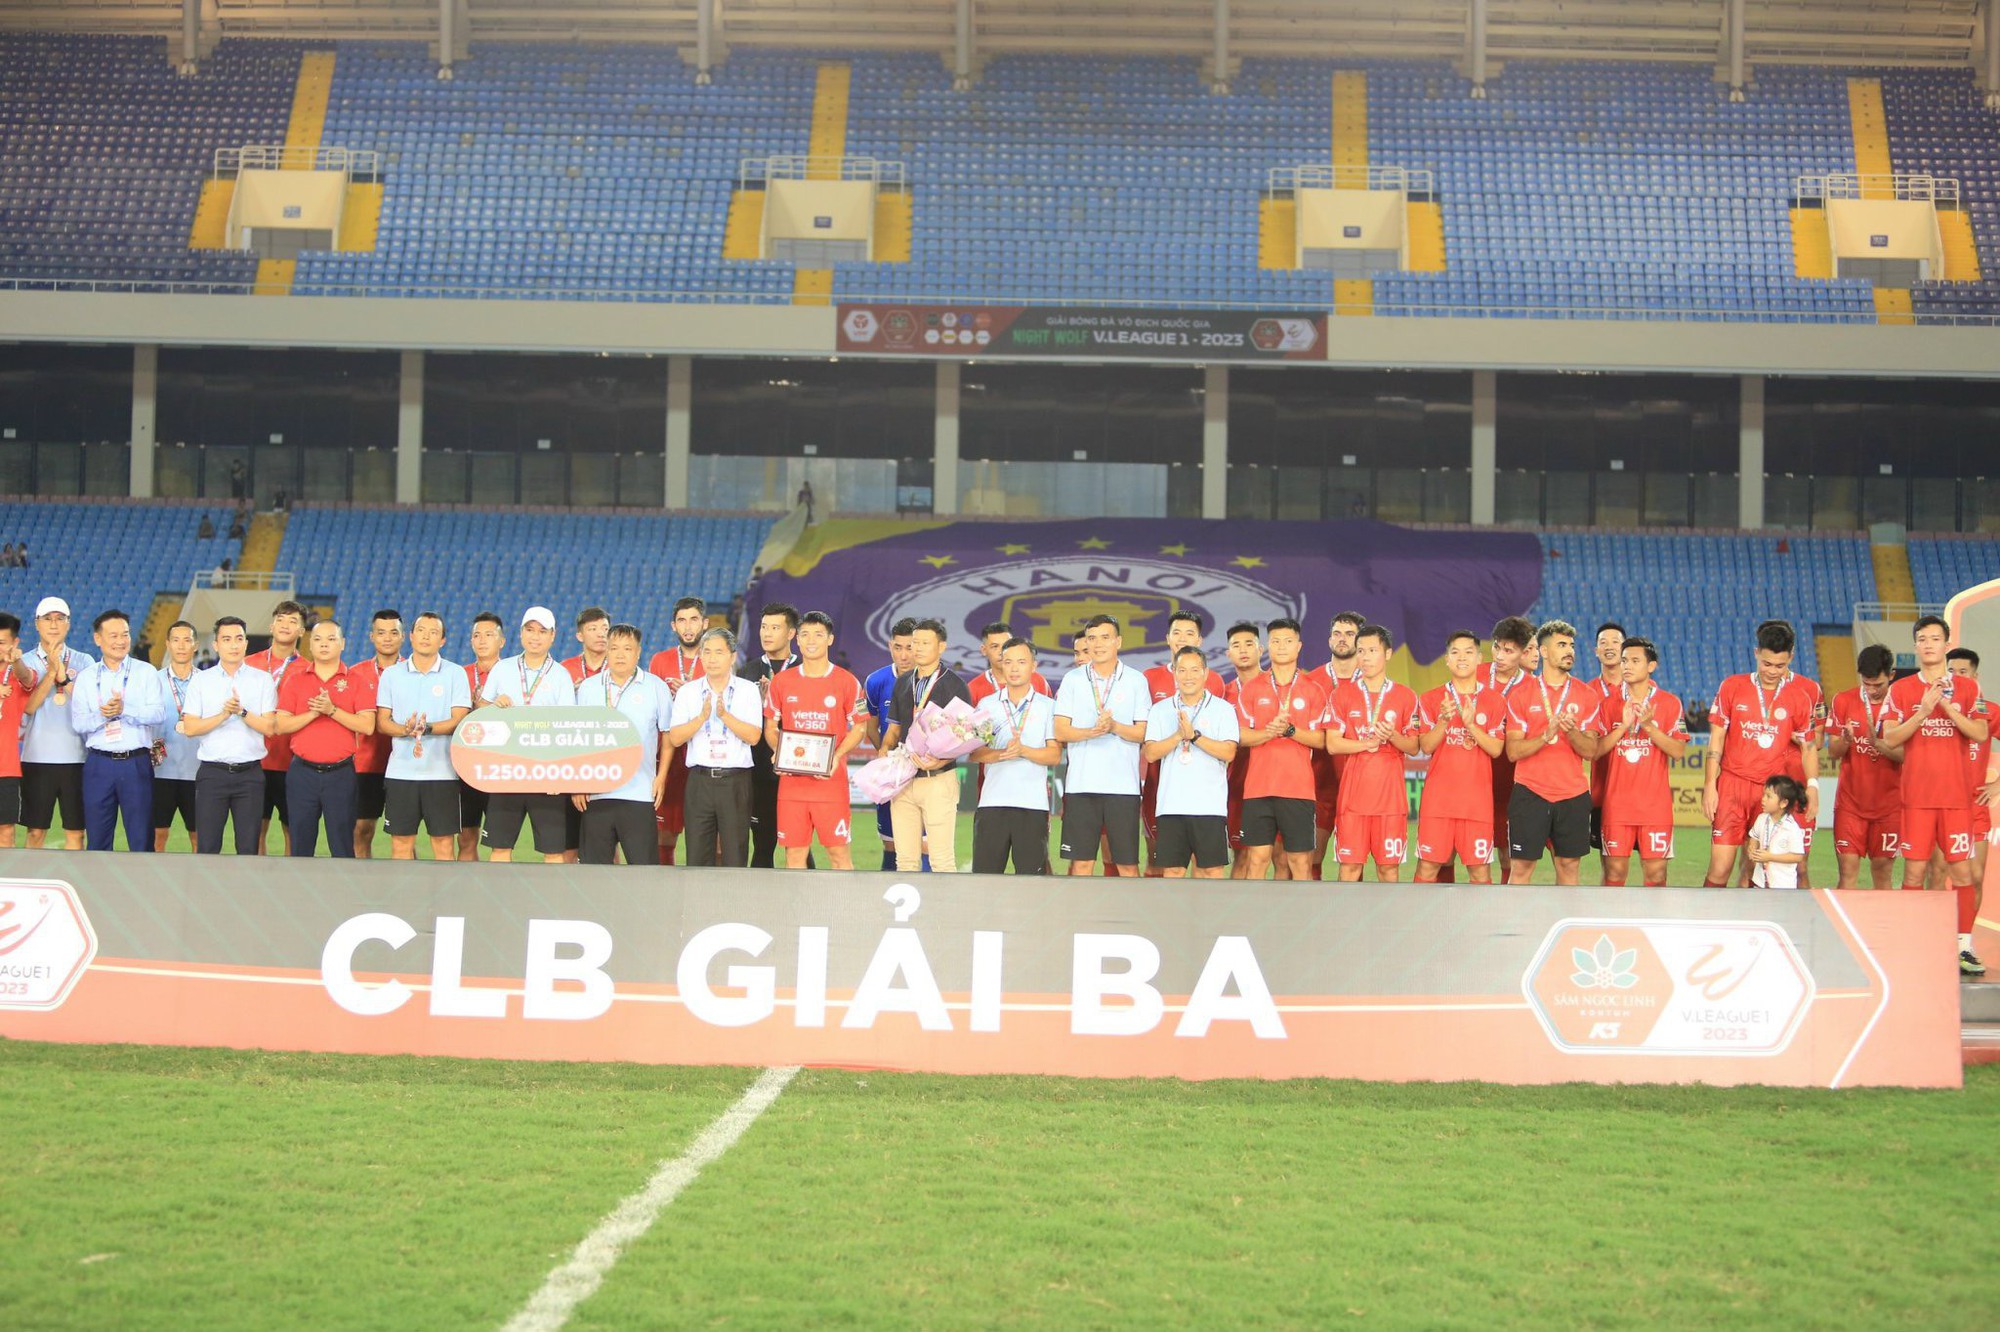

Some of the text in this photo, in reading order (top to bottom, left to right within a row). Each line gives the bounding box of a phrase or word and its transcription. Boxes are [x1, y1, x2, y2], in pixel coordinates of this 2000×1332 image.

[1069, 315, 1098, 327] BÓNG
[1192, 320, 1211, 329] GIA
[1012, 329, 1050, 346] NIGHT
[1053, 330, 1090, 345] WOLF
[1092, 330, 1177, 346] V.LEAGUE
[1180, 332, 1189, 346] 1
[1201, 332, 1245, 347] 2023
[961, 566, 1228, 597] HANOI
[792, 711, 829, 721] viettel
[795, 720, 826, 731] tv360
[1922, 727, 1955, 738] tv360
[519, 729, 618, 747] CLB GIẢI BA
[474, 763, 623, 780] 1.250.000.000
[834, 818, 848, 837] 4
[1384, 838, 1403, 858] 90
[1474, 838, 1488, 859] 8
[1648, 832, 1668, 852] 15
[1881, 833, 1898, 851] 12
[1949, 833, 1970, 854] 28
[321, 883, 1288, 1039] CLB GIẢI BA
[1623, 994, 1656, 1008] LINH
[1681, 1009, 1770, 1024] V.LEAGUE 1
[1702, 1027, 1748, 1041] 2023
